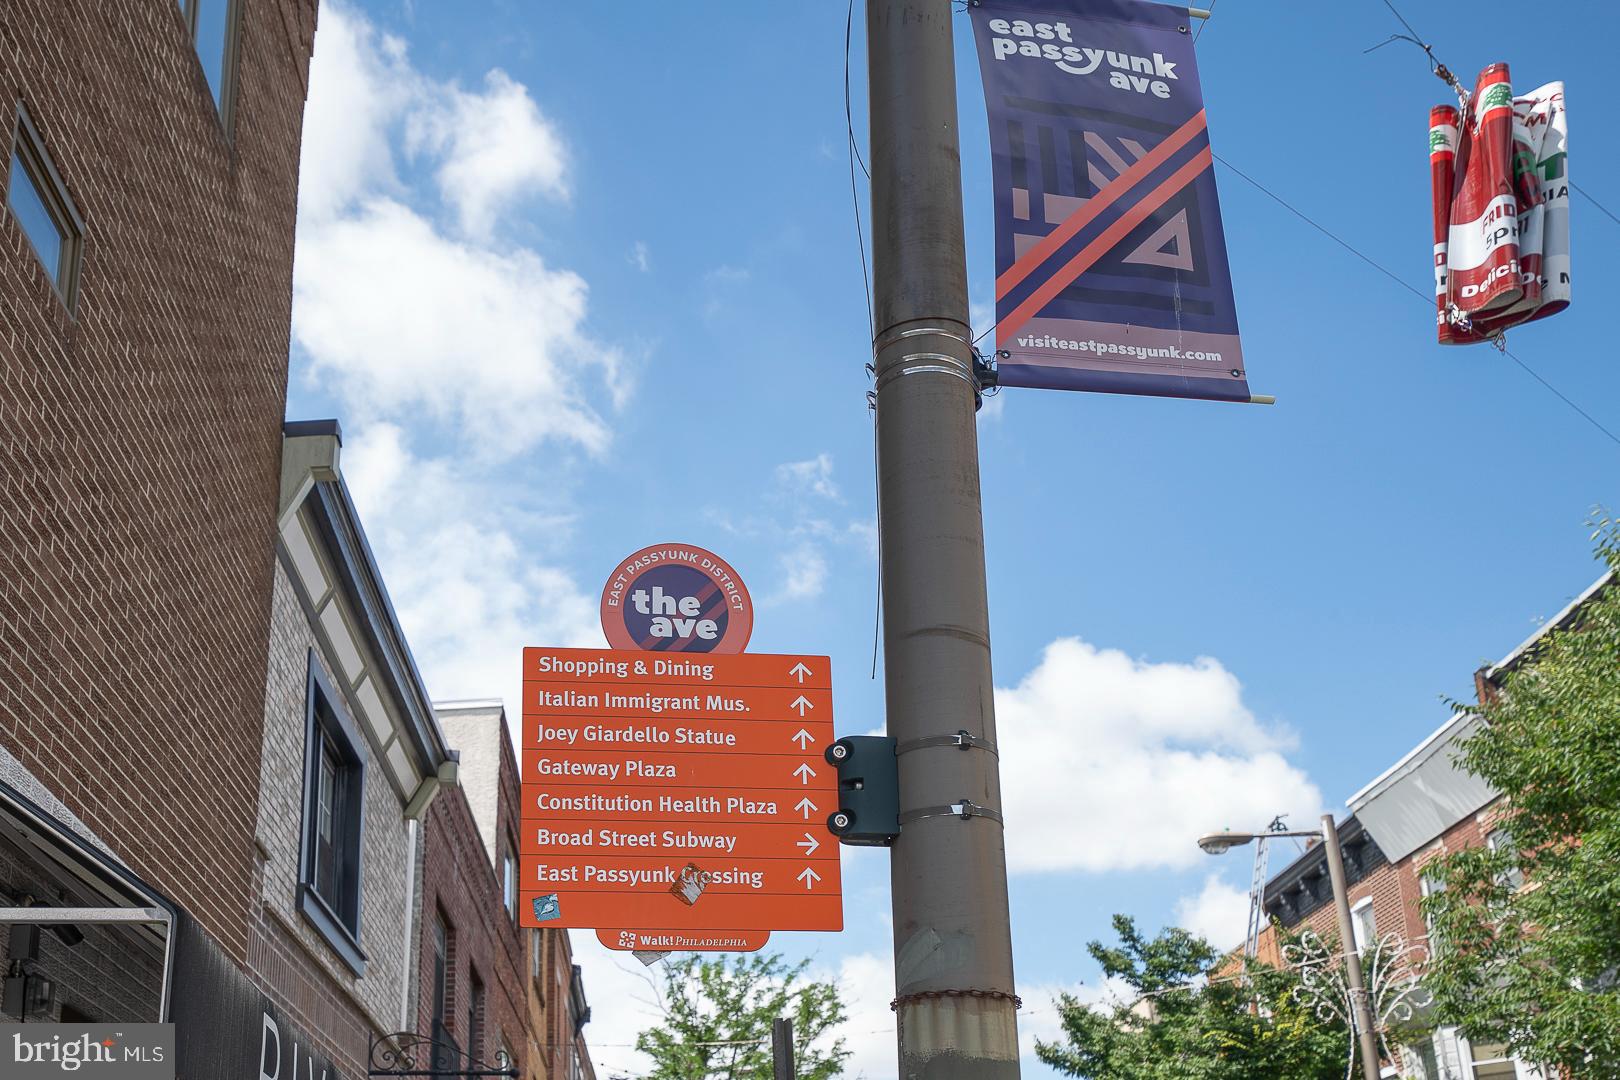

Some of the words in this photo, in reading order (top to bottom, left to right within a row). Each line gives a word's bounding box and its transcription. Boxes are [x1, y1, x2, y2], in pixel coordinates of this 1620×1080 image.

[989, 18, 1073, 43] east
[992, 37, 1179, 80] passyunk
[1109, 71, 1171, 99] ave
[1017, 334, 1223, 362] visiteastpassyunk.com
[608, 573, 628, 607] EAST
[626, 550, 699, 575] PASSYUNK
[700, 558, 743, 611] DISTRICT
[631, 586, 700, 616] the
[649, 616, 718, 640] ave
[538, 656, 629, 678] Shopping
[633, 660, 649, 675] &
[654, 659, 715, 681] Dining
[538, 690, 599, 708] Italian
[605, 692, 701, 713] Immigrant
[705, 695, 751, 712] Mus.
[537, 724, 579, 745] Joey
[583, 725, 670, 743] Giardello
[674, 727, 736, 746] Statue
[537, 758, 621, 781] Gateway
[625, 760, 677, 778] Plaza
[537, 793, 653, 812] Constitution
[658, 796, 722, 813] Health
[726, 797, 778, 815] Plaza
[537, 828, 594, 846] Broad
[598, 829, 658, 848] Street
[662, 830, 737, 853] Subway
[537, 864, 579, 882] East
[584, 865, 676, 887] Passyunk
[640, 935, 674, 946] Walk!
